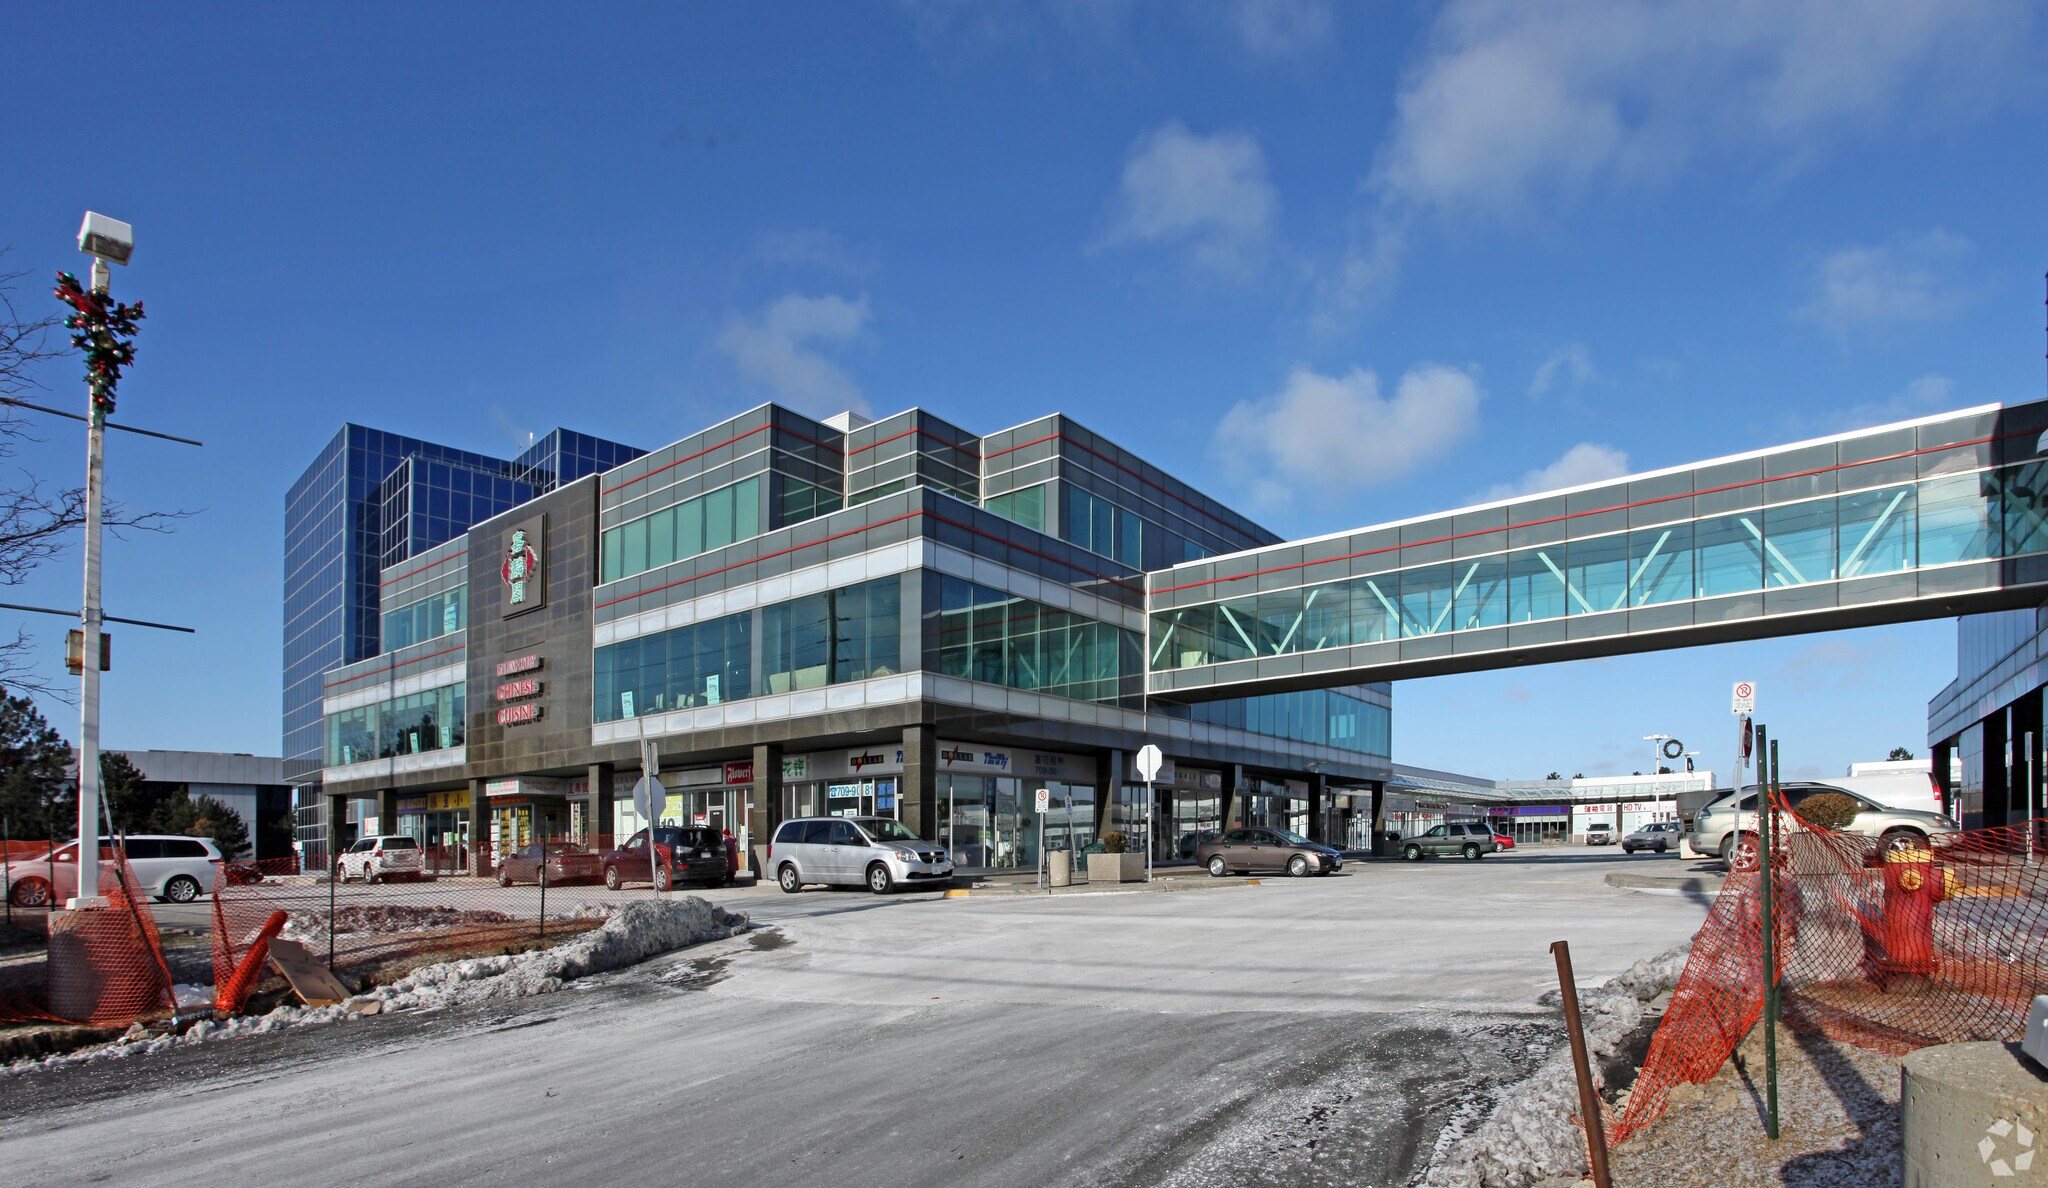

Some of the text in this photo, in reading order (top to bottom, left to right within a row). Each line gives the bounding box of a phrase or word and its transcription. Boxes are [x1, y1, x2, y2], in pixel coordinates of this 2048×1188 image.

[496, 678, 537, 700] CHINESE
[497, 703, 536, 725] CUISINE
[851, 755, 883, 766] DOLLAR
[942, 750, 1008, 769] DOLLAR Thrifty
